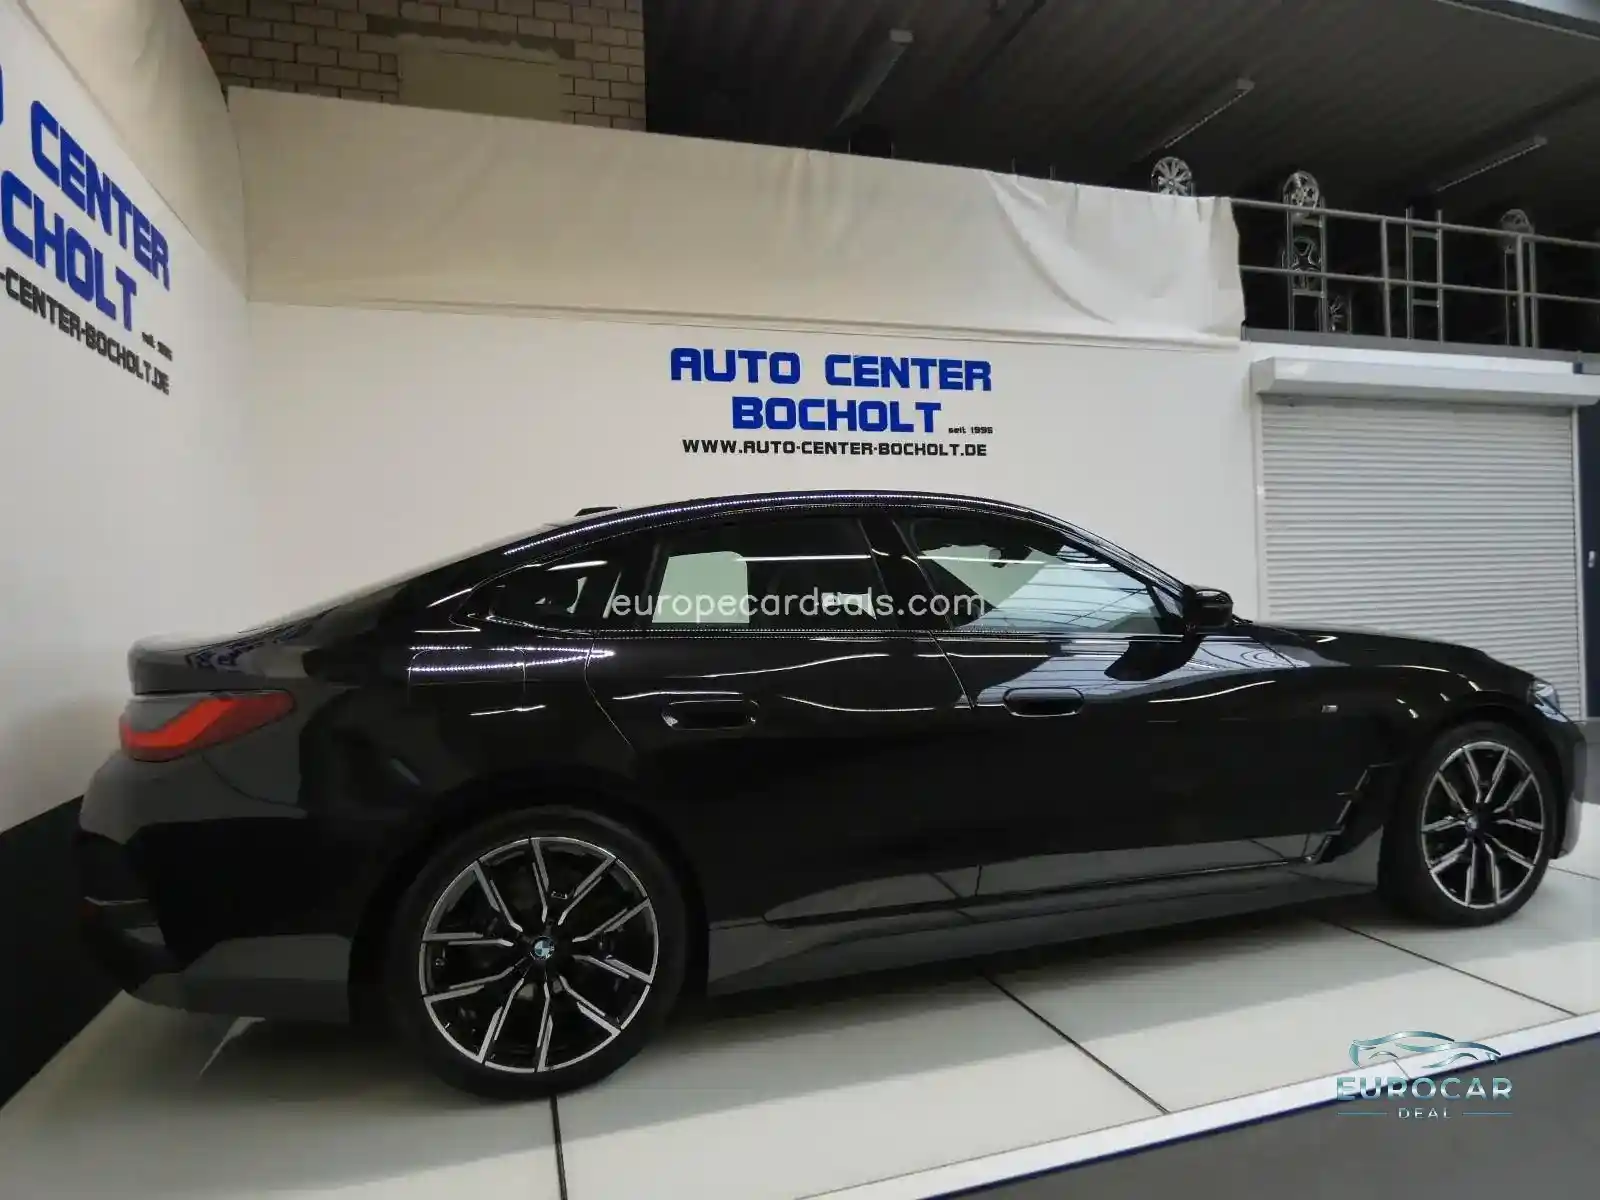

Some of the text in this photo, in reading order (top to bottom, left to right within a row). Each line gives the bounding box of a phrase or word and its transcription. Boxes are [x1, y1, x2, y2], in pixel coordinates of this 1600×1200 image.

[31, 100, 171, 292] CENTER
[670, 347, 992, 392] AUTO CENTER
[732, 396, 942, 433] BOCHOLT
[682, 439, 988, 457] WWW.AUTO-CENTER-BOCHOLT.DE
